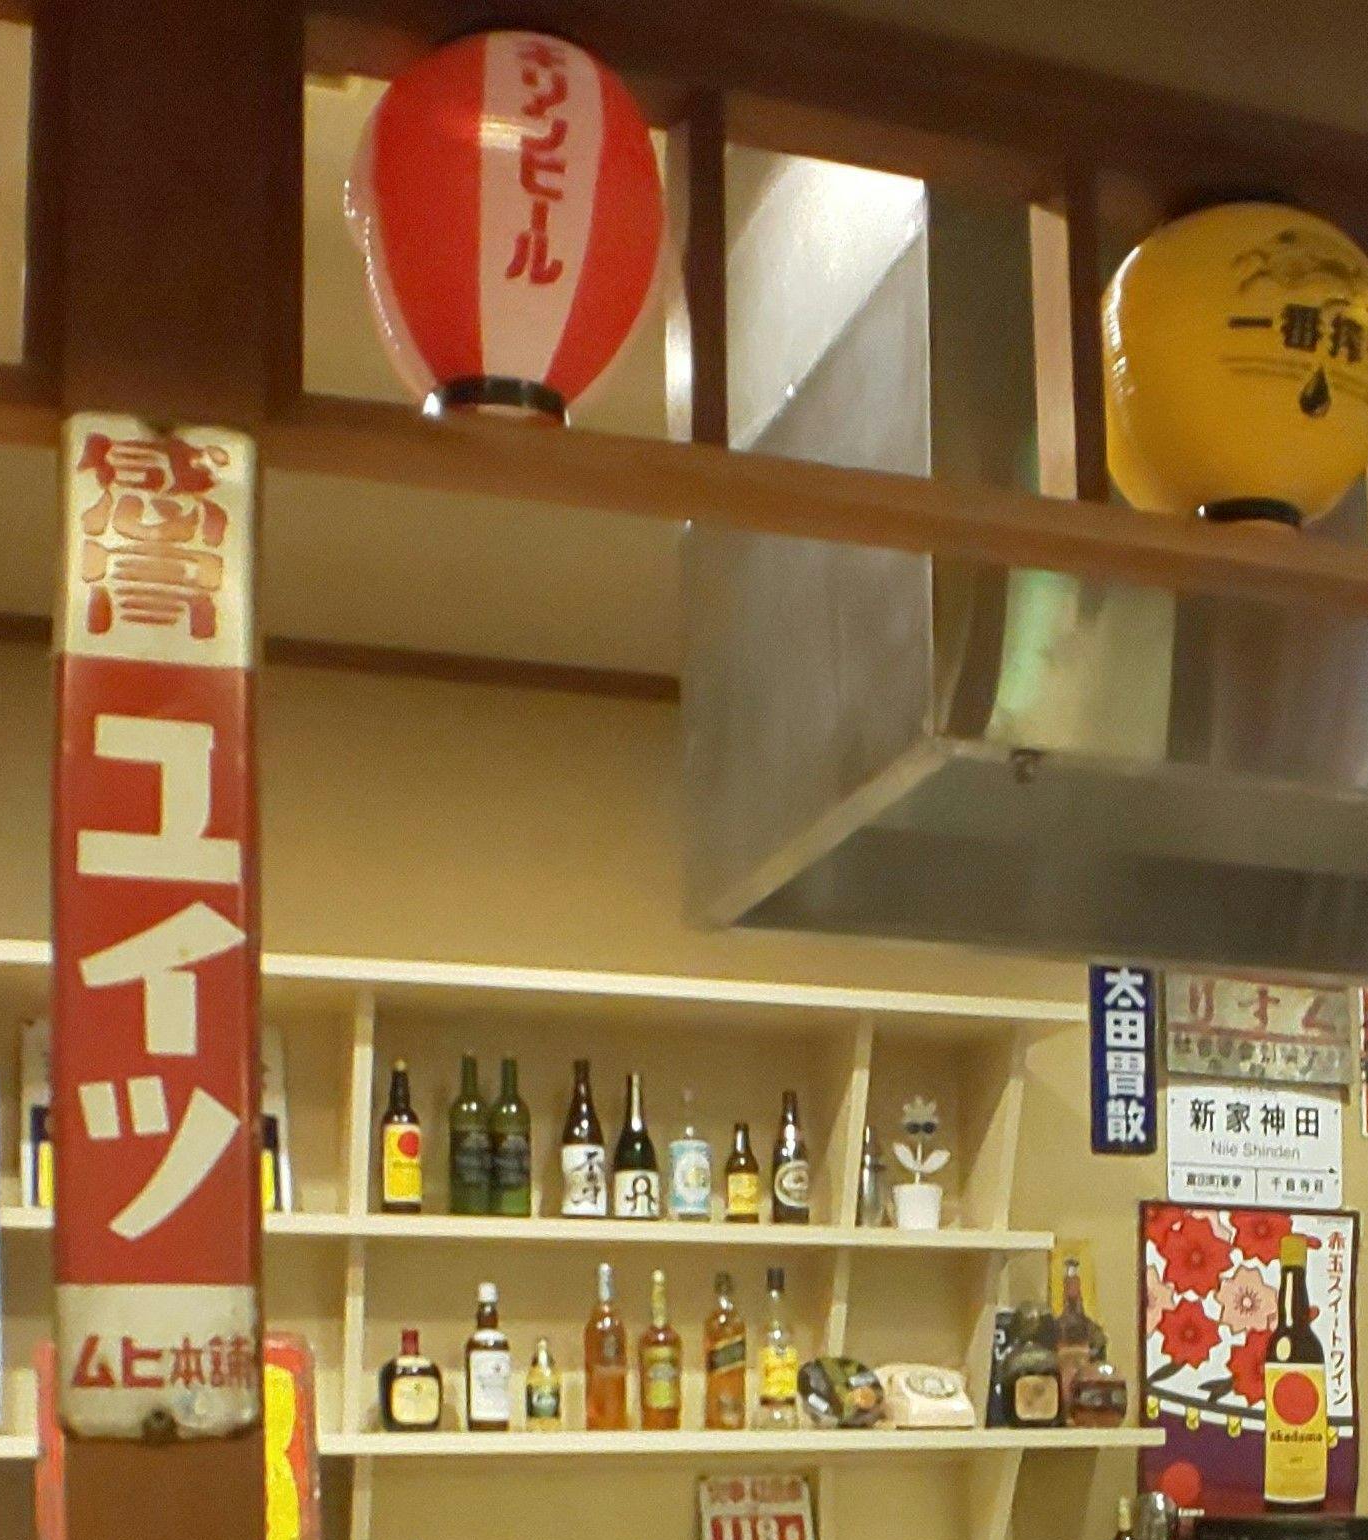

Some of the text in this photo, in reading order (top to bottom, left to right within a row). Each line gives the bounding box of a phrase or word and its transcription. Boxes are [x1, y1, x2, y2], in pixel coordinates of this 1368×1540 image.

[77, 714, 246, 1241] ユイツ
[1103, 966, 1146, 1143] 太田胃散
[1189, 1097, 1321, 1138] 新家神田
[1326, 1231, 1349, 1406] 赤玉スイートワイン
